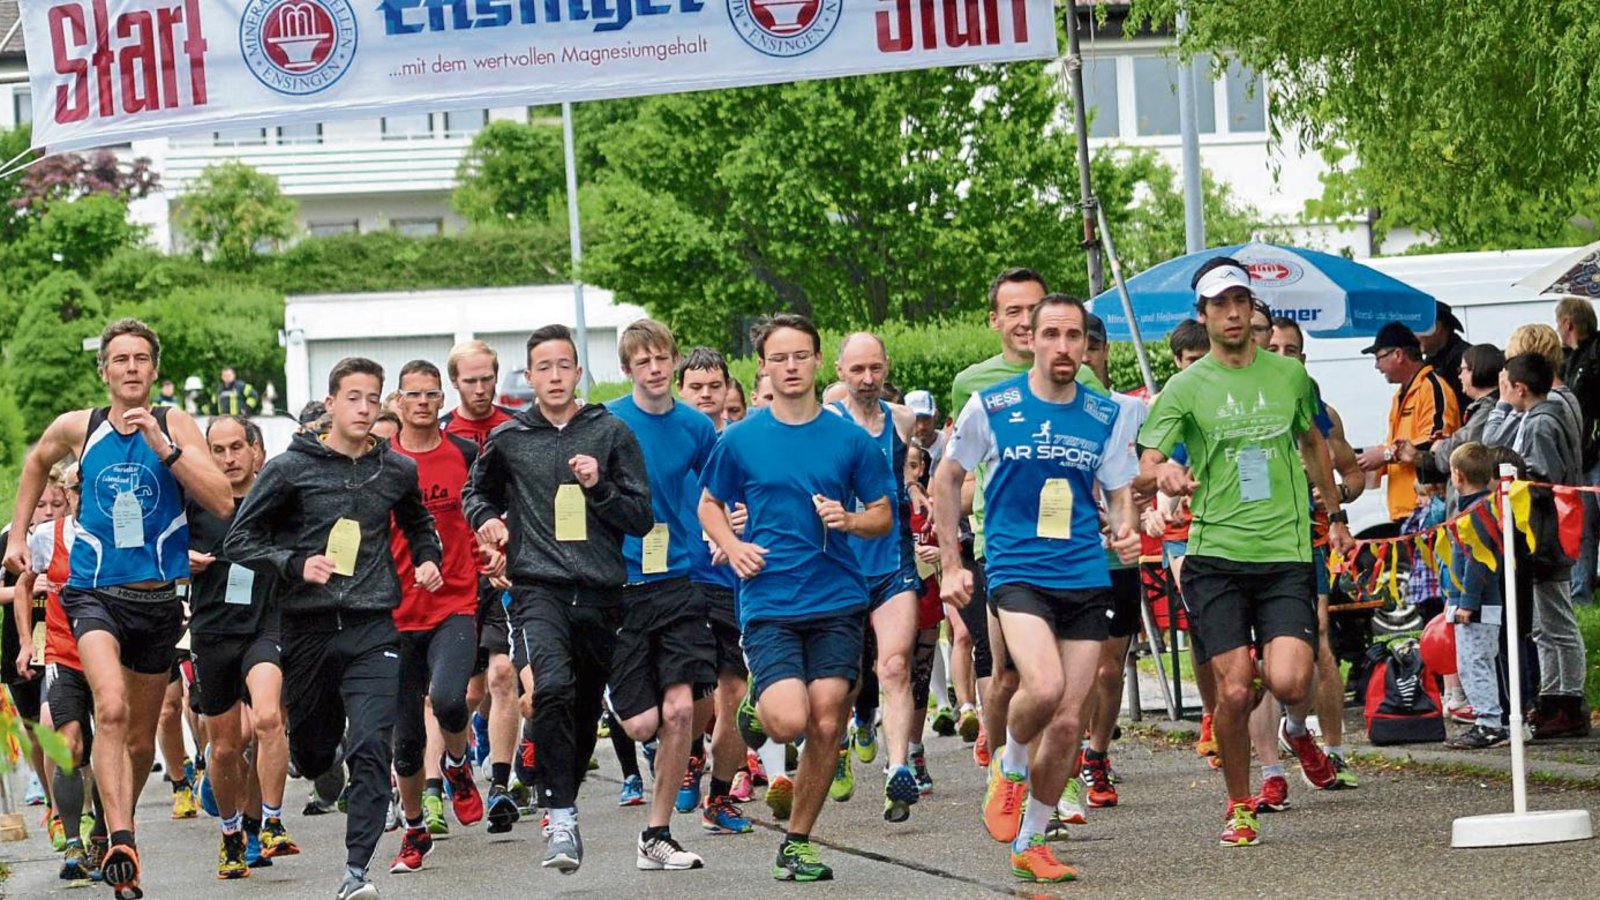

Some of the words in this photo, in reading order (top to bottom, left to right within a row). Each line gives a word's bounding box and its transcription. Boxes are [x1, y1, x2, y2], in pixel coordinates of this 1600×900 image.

[748, 24, 825, 52] ENSINGEN
[48, 0, 207, 124] Start
[432, 54, 467, 73] dem
[474, 46, 556, 69] wertvollen
[561, 35, 708, 66] Magnesiumgehalt
[262, 60, 340, 89] ENSINGEN
[985, 390, 1021, 409] HESS
[1003, 446, 1032, 460] AR
